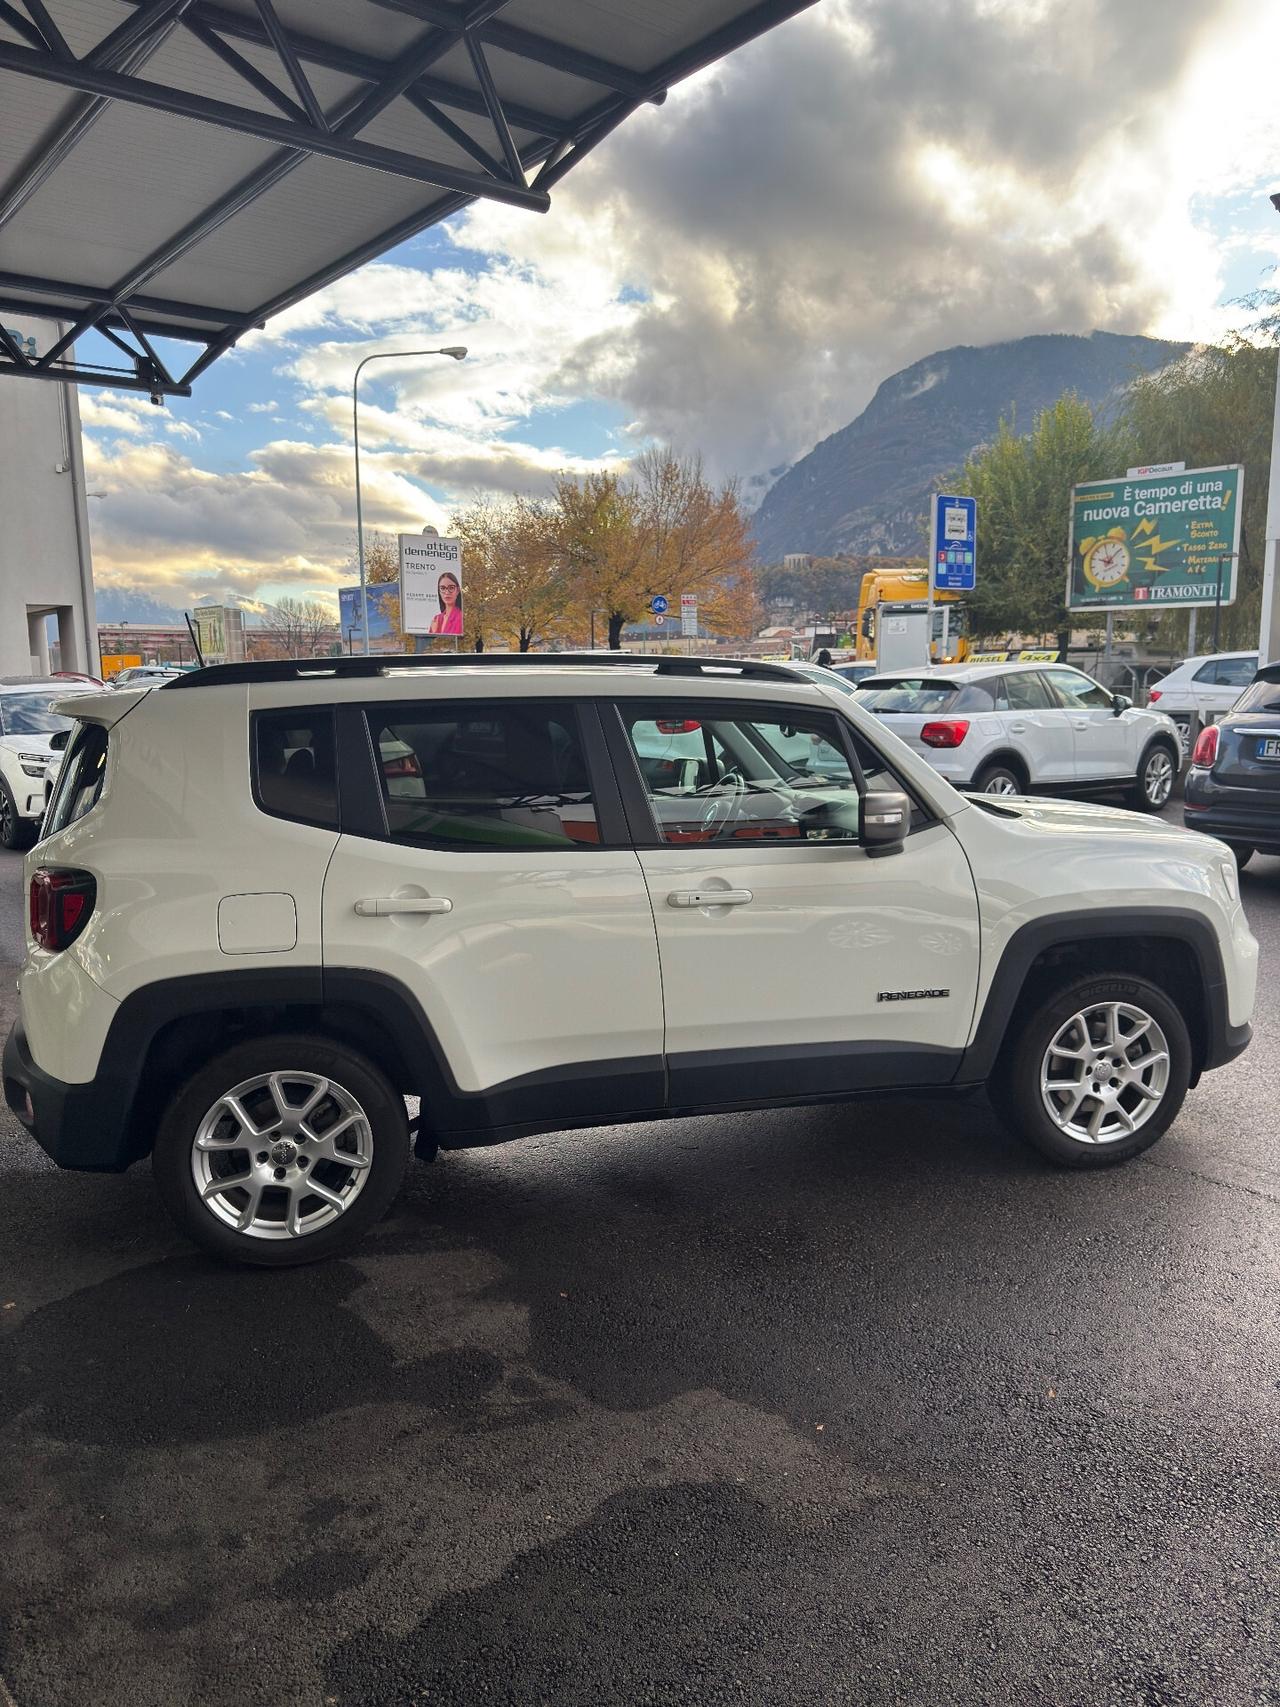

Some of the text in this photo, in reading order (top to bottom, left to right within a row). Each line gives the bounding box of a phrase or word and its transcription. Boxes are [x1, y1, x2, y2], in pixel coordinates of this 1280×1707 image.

[1123, 486, 1133, 501] È
[1134, 487, 1177, 503] tempo
[1180, 482, 1193, 495] di
[1196, 480, 1223, 493] una
[1083, 490, 1232, 521] nuova Cameretta!
[404, 546, 458, 560] demenego
[426, 542, 458, 552] ottica
[405, 562, 437, 571] TRENTO
[877, 988, 950, 1002] RENEGADE
